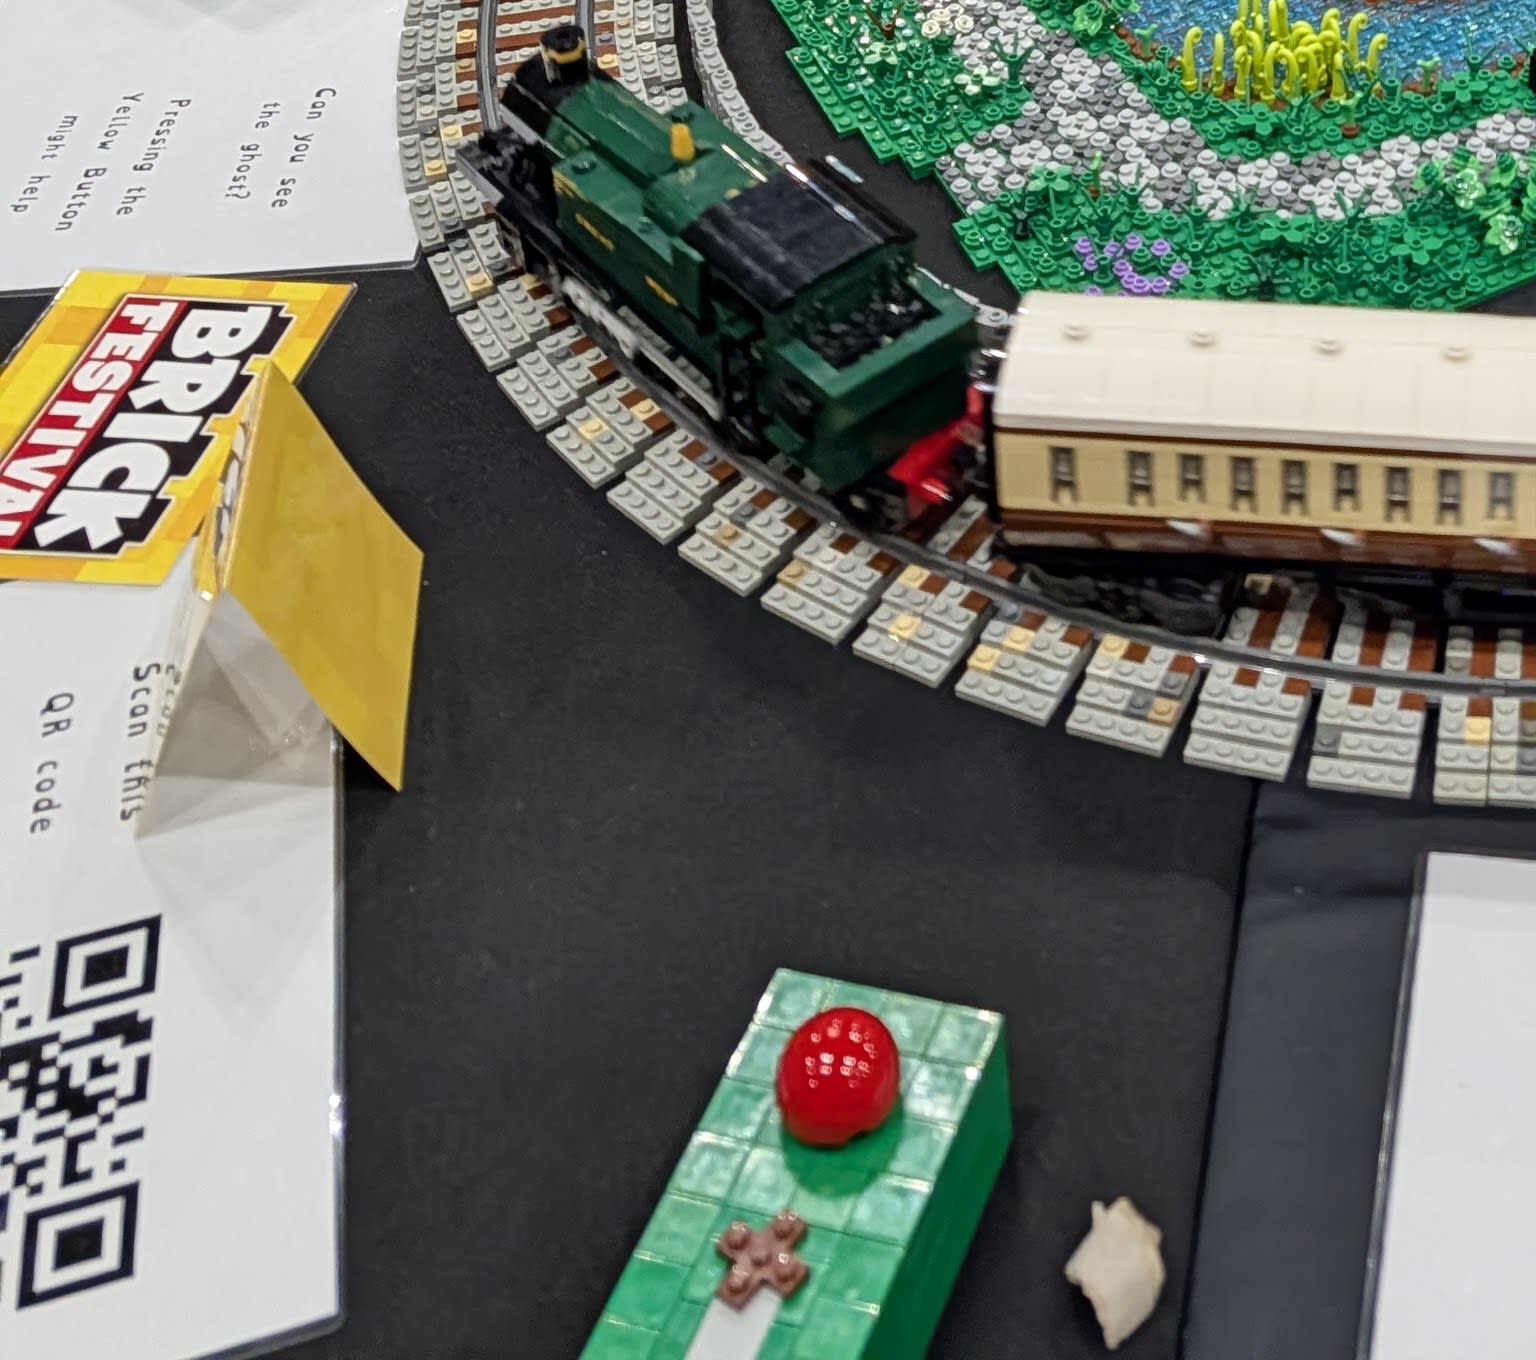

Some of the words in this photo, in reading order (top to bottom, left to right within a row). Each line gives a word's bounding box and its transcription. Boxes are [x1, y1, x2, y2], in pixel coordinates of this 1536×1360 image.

[97, 92, 144, 151] Yellow
[254, 101, 281, 130] the
[306, 87, 337, 120] Can
[41, 115, 78, 161] might
[132, 98, 192, 172] Pressing
[288, 132, 315, 164] you
[9, 175, 51, 214] help
[225, 143, 263, 201] ghost?
[271, 177, 297, 209] see
[55, 167, 107, 233] Button
[116, 186, 147, 217] the
[34, 306, 273, 551] BRICK
[40, 692, 75, 738] QR
[128, 663, 161, 738] Scan
[29, 760, 63, 834] code
[120, 759, 154, 821] this
